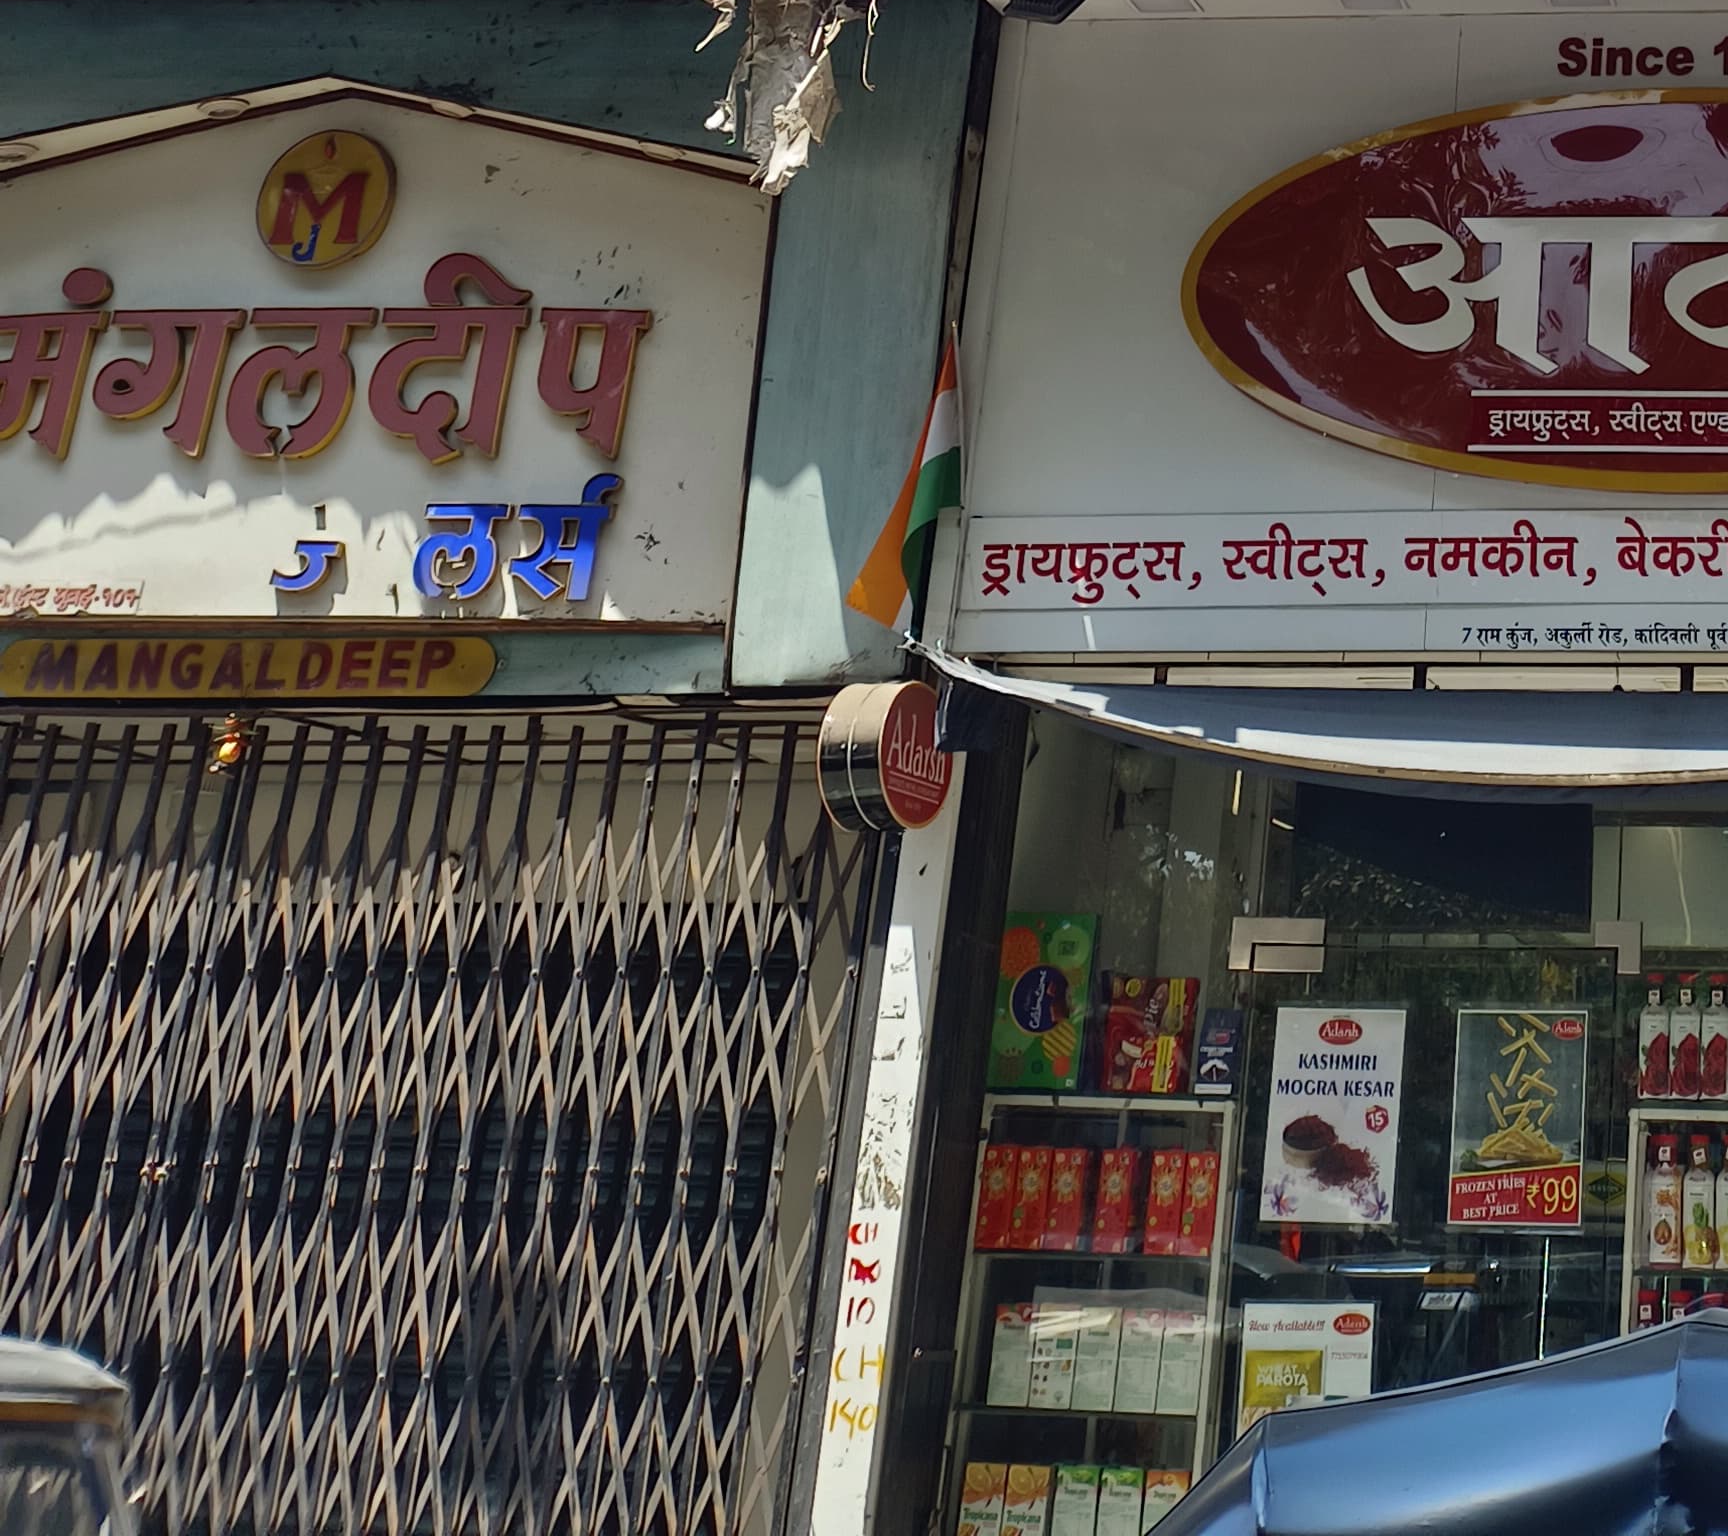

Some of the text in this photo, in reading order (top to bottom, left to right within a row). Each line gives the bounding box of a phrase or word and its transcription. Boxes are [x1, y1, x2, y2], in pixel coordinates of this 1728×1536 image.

[1557, 37, 1695, 78] Since
[0, 252, 653, 464] मंगलदीप
[1404, 520, 1598, 588] नमकीन,
[1476, 628, 1502, 645] राम
[1505, 622, 1538, 649] कुंज,
[1545, 622, 1595, 649] अकुर्ली
[1598, 624, 1629, 647] रोड,
[26, 639, 456, 692] MANGALDEEP
[1298, 1052, 1378, 1071] KASHMIRI
[1343, 1080, 1395, 1098] KESAR
[1455, 1179, 1496, 1195] FROZEN
[1483, 1192, 1498, 1205] AT
[1462, 1203, 1520, 1220] BEST PRICE
[1255, 1373, 1309, 1388] PAROTA
[963, 1507, 999, 1522] Tropicana
[1005, 1510, 1042, 1525] Tropicana
